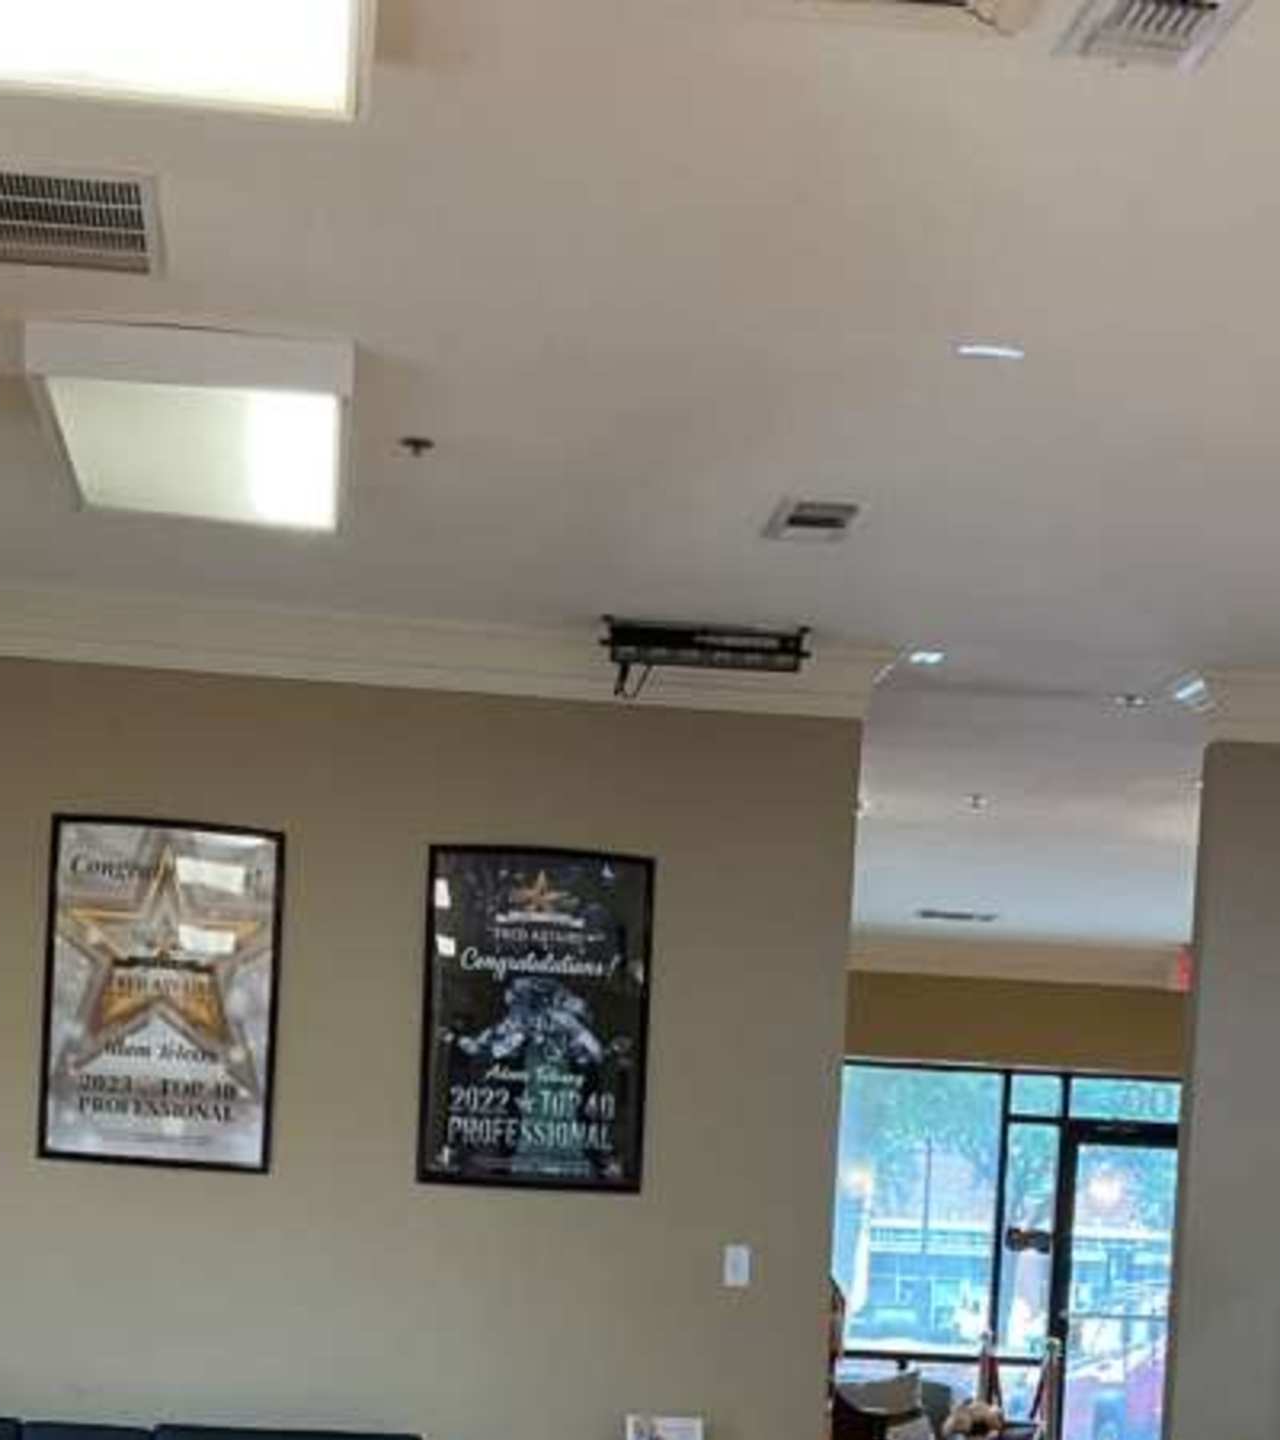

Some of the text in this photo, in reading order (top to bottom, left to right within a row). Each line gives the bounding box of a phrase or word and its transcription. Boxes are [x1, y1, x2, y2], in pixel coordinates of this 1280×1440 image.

[161, 1077, 204, 1098] TOP
[449, 1086, 510, 1115] 2022
[539, 1089, 581, 1118] TOP
[79, 1095, 234, 1124] PROFESSIONAL
[447, 1115, 614, 1151] PROFESSIONAL
